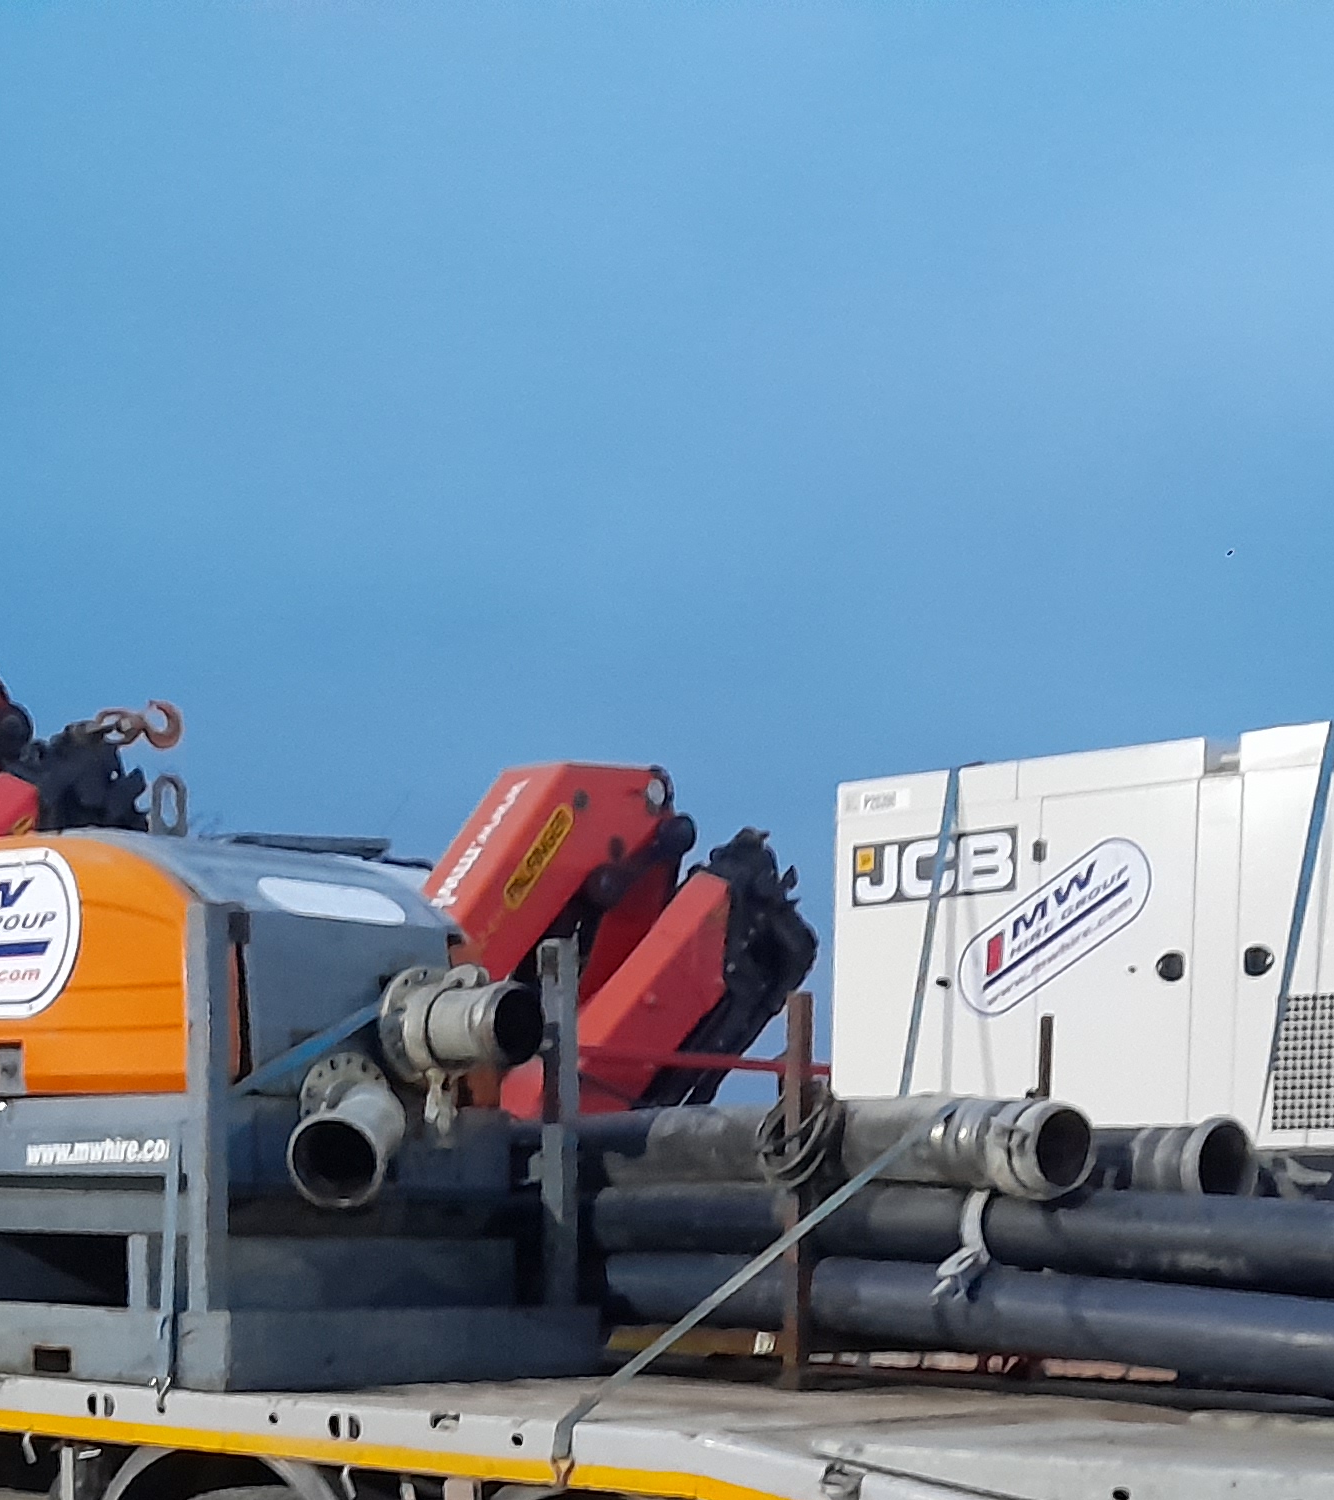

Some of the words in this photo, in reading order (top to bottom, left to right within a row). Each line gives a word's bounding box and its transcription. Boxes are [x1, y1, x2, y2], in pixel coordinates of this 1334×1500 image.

[854, 831, 1014, 905] JCB
[1011, 859, 1098, 941] MW
[25, 1137, 171, 1166] www.mwhire.co
